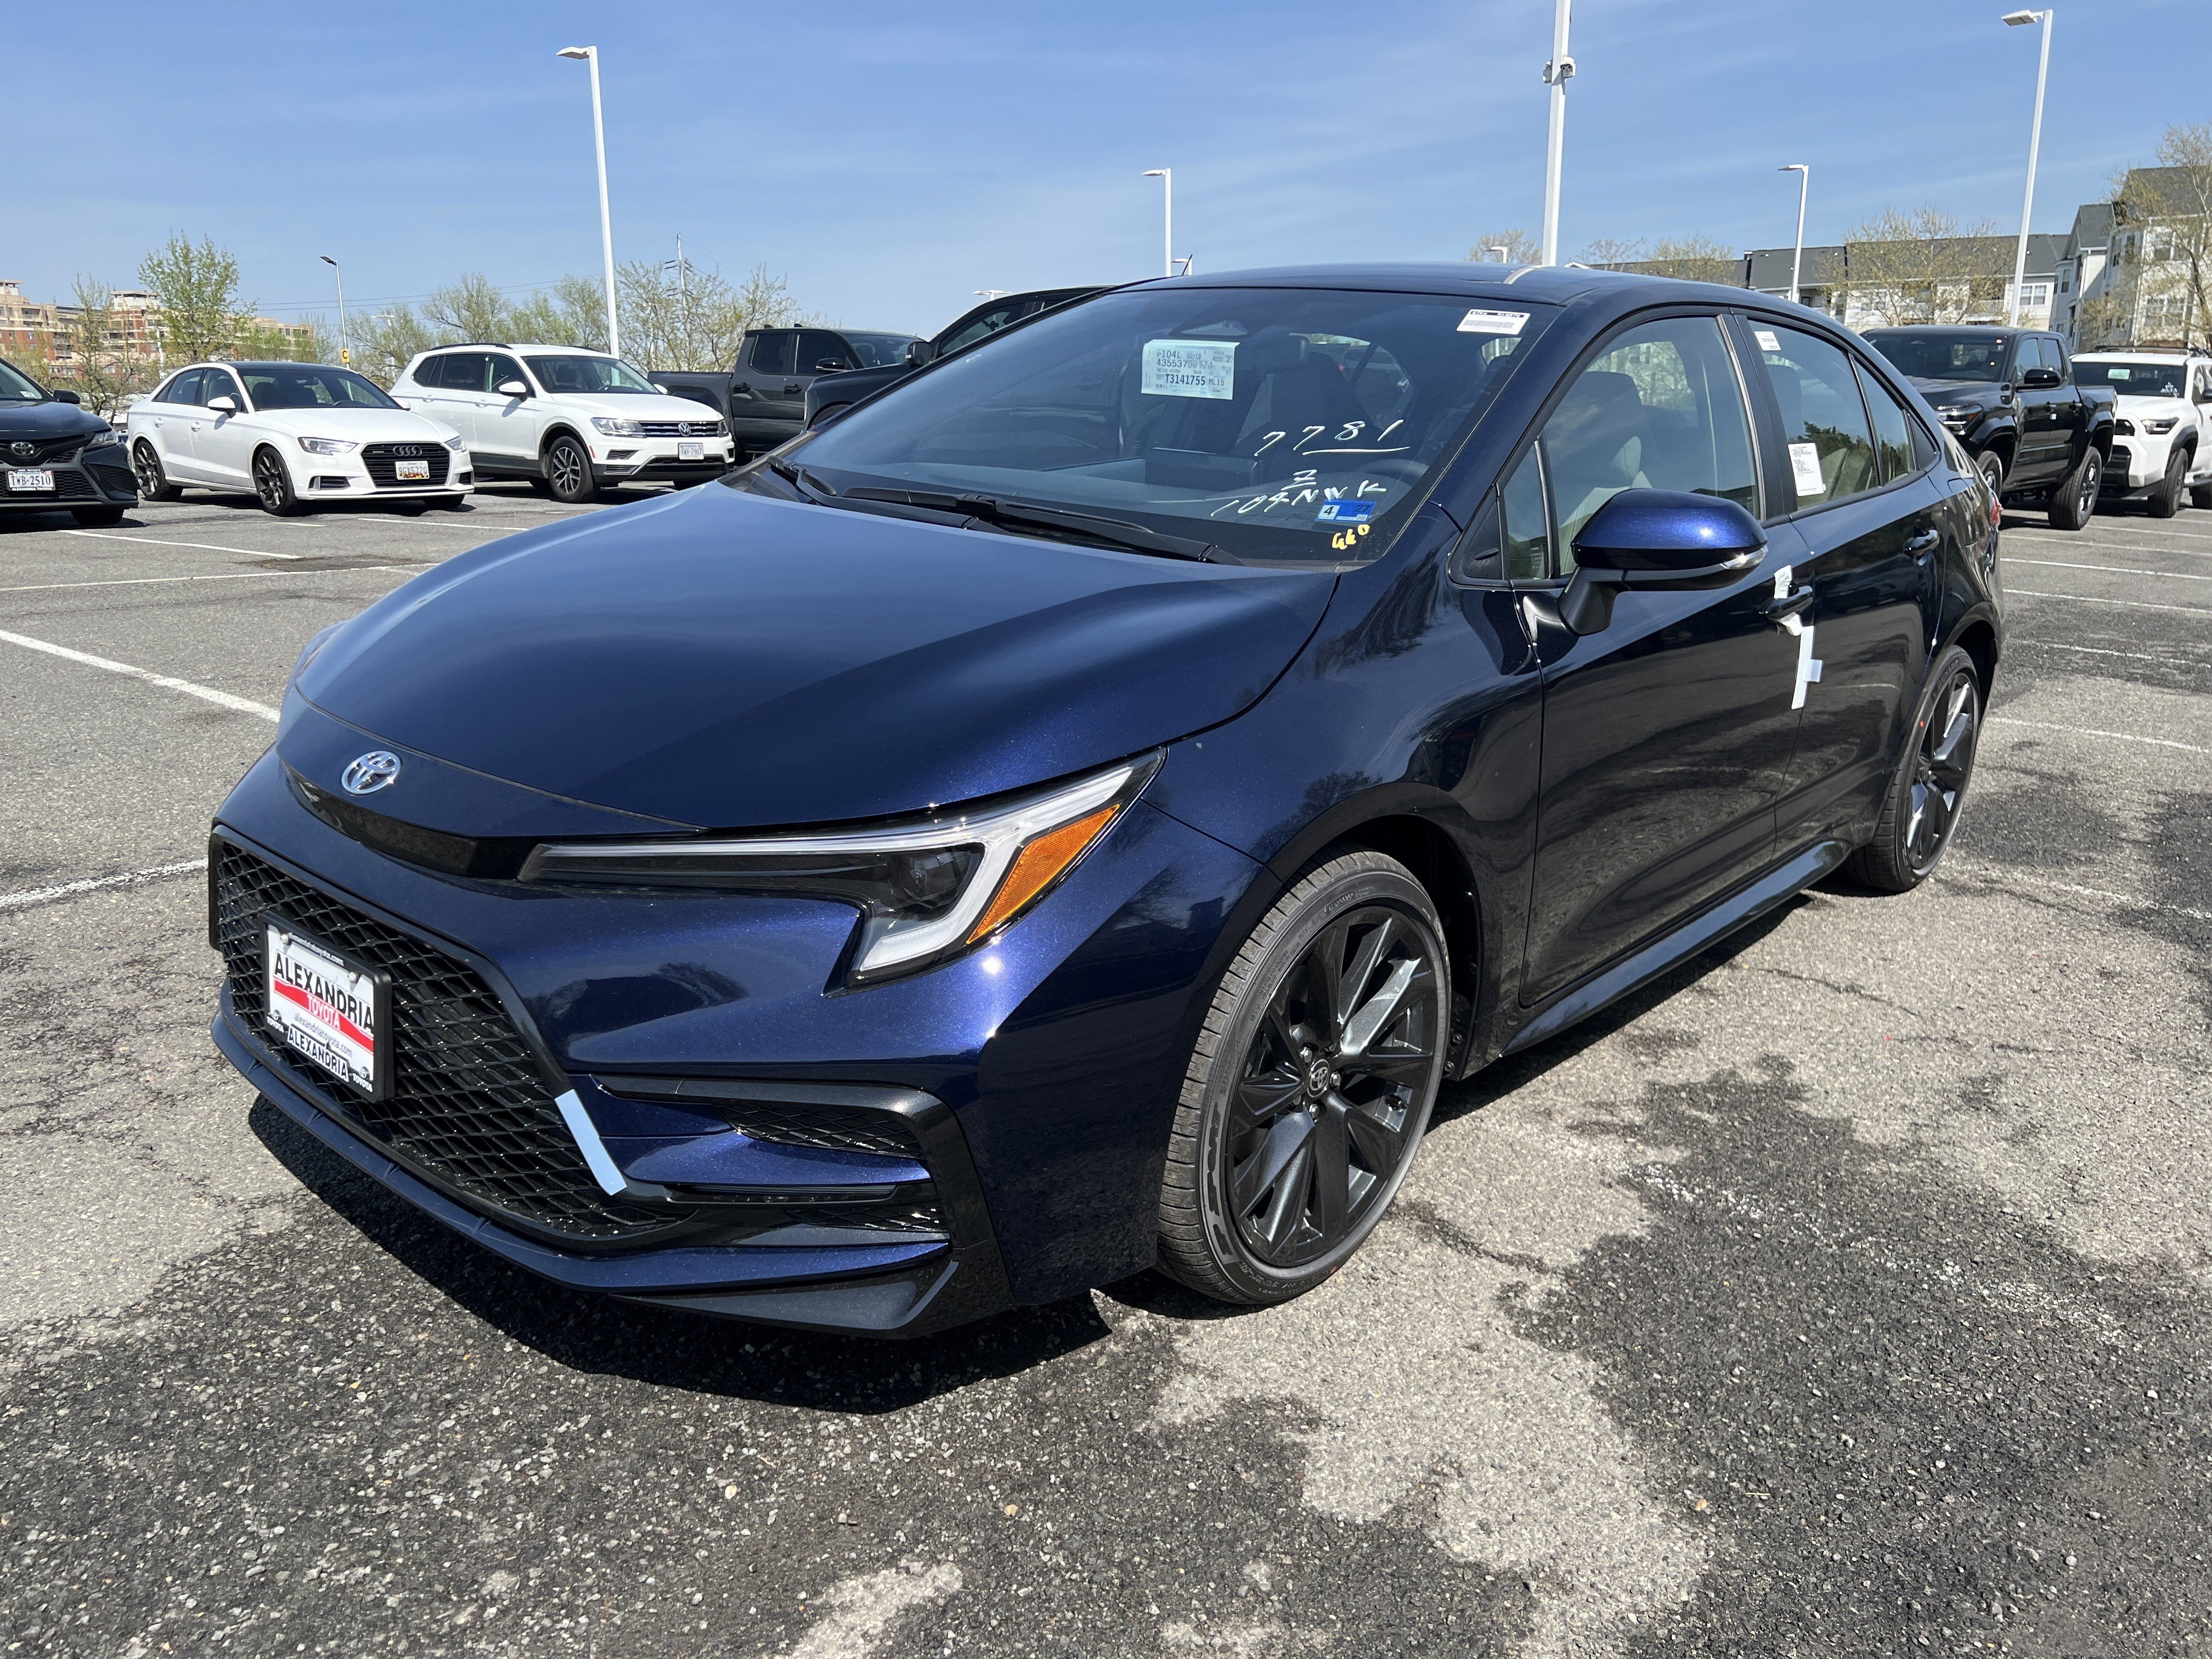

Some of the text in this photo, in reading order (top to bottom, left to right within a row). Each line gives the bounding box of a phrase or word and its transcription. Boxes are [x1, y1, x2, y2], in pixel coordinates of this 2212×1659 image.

[342, 350, 348, 359] C
[1165, 374, 1206, 386] T3141755
[10, 476, 50, 486] TWB-2510
[1324, 506, 1334, 515] 4
[274, 952, 374, 1030] ALEXANDRIA
[307, 995, 341, 1030] TOYOTA
[266, 1016, 285, 1033] TOYOTA
[295, 1013, 353, 1059] alexandriatoyota.com
[289, 1026, 347, 1079] ALEXANDRIA
[352, 1073, 373, 1092] TOYOTA
